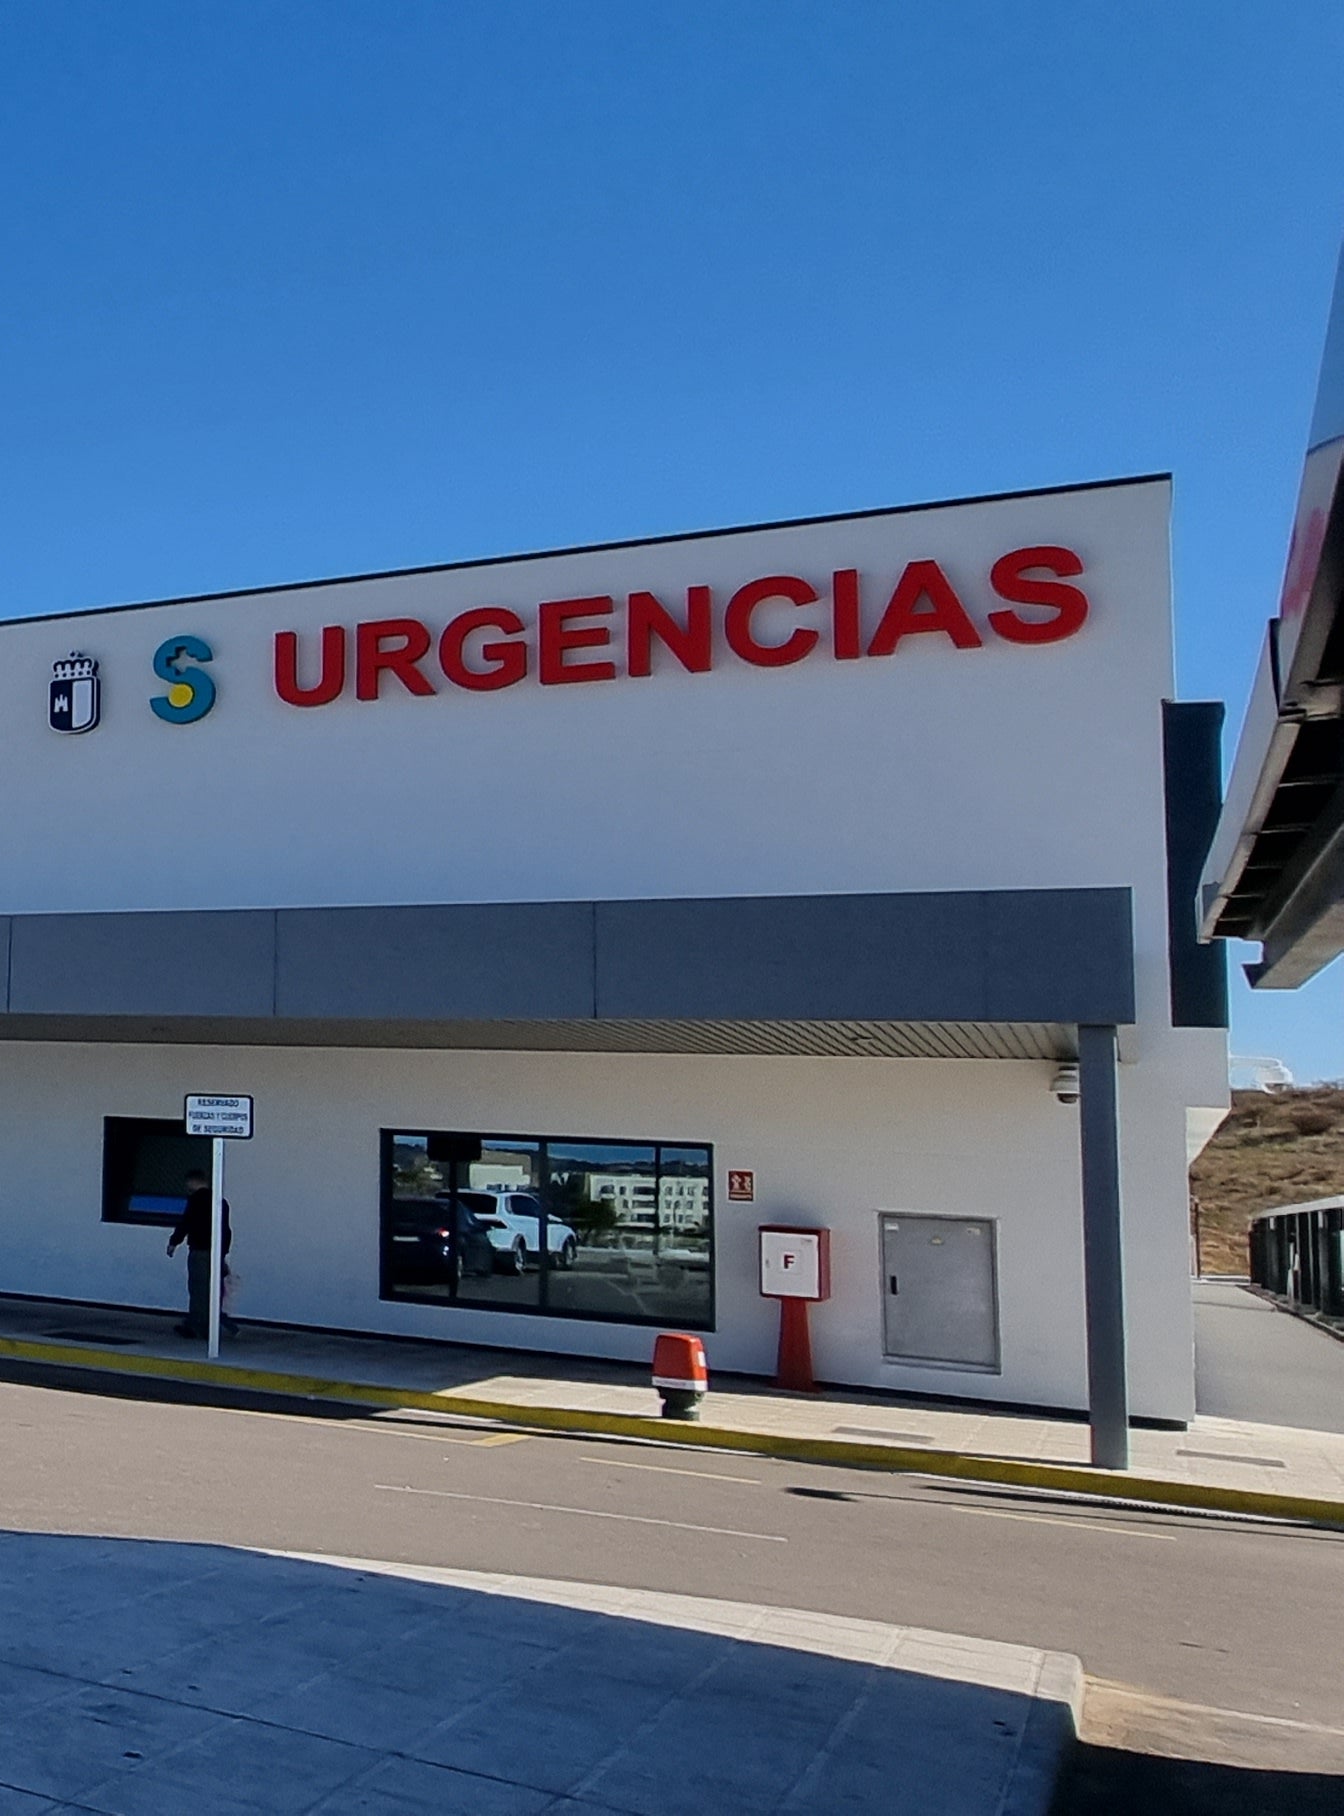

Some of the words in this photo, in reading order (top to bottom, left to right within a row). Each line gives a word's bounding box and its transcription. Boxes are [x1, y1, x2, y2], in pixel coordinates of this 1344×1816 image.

[275, 546, 1089, 708] URGENCIAS
[198, 1098, 240, 1107] RESERVADO
[189, 1111, 214, 1120] FUERZAS
[221, 1112, 248, 1121] CUERPOS
[192, 1124, 201, 1133] DE
[204, 1125, 244, 1134] SEGURIDAD
[783, 1254, 795, 1269] F
